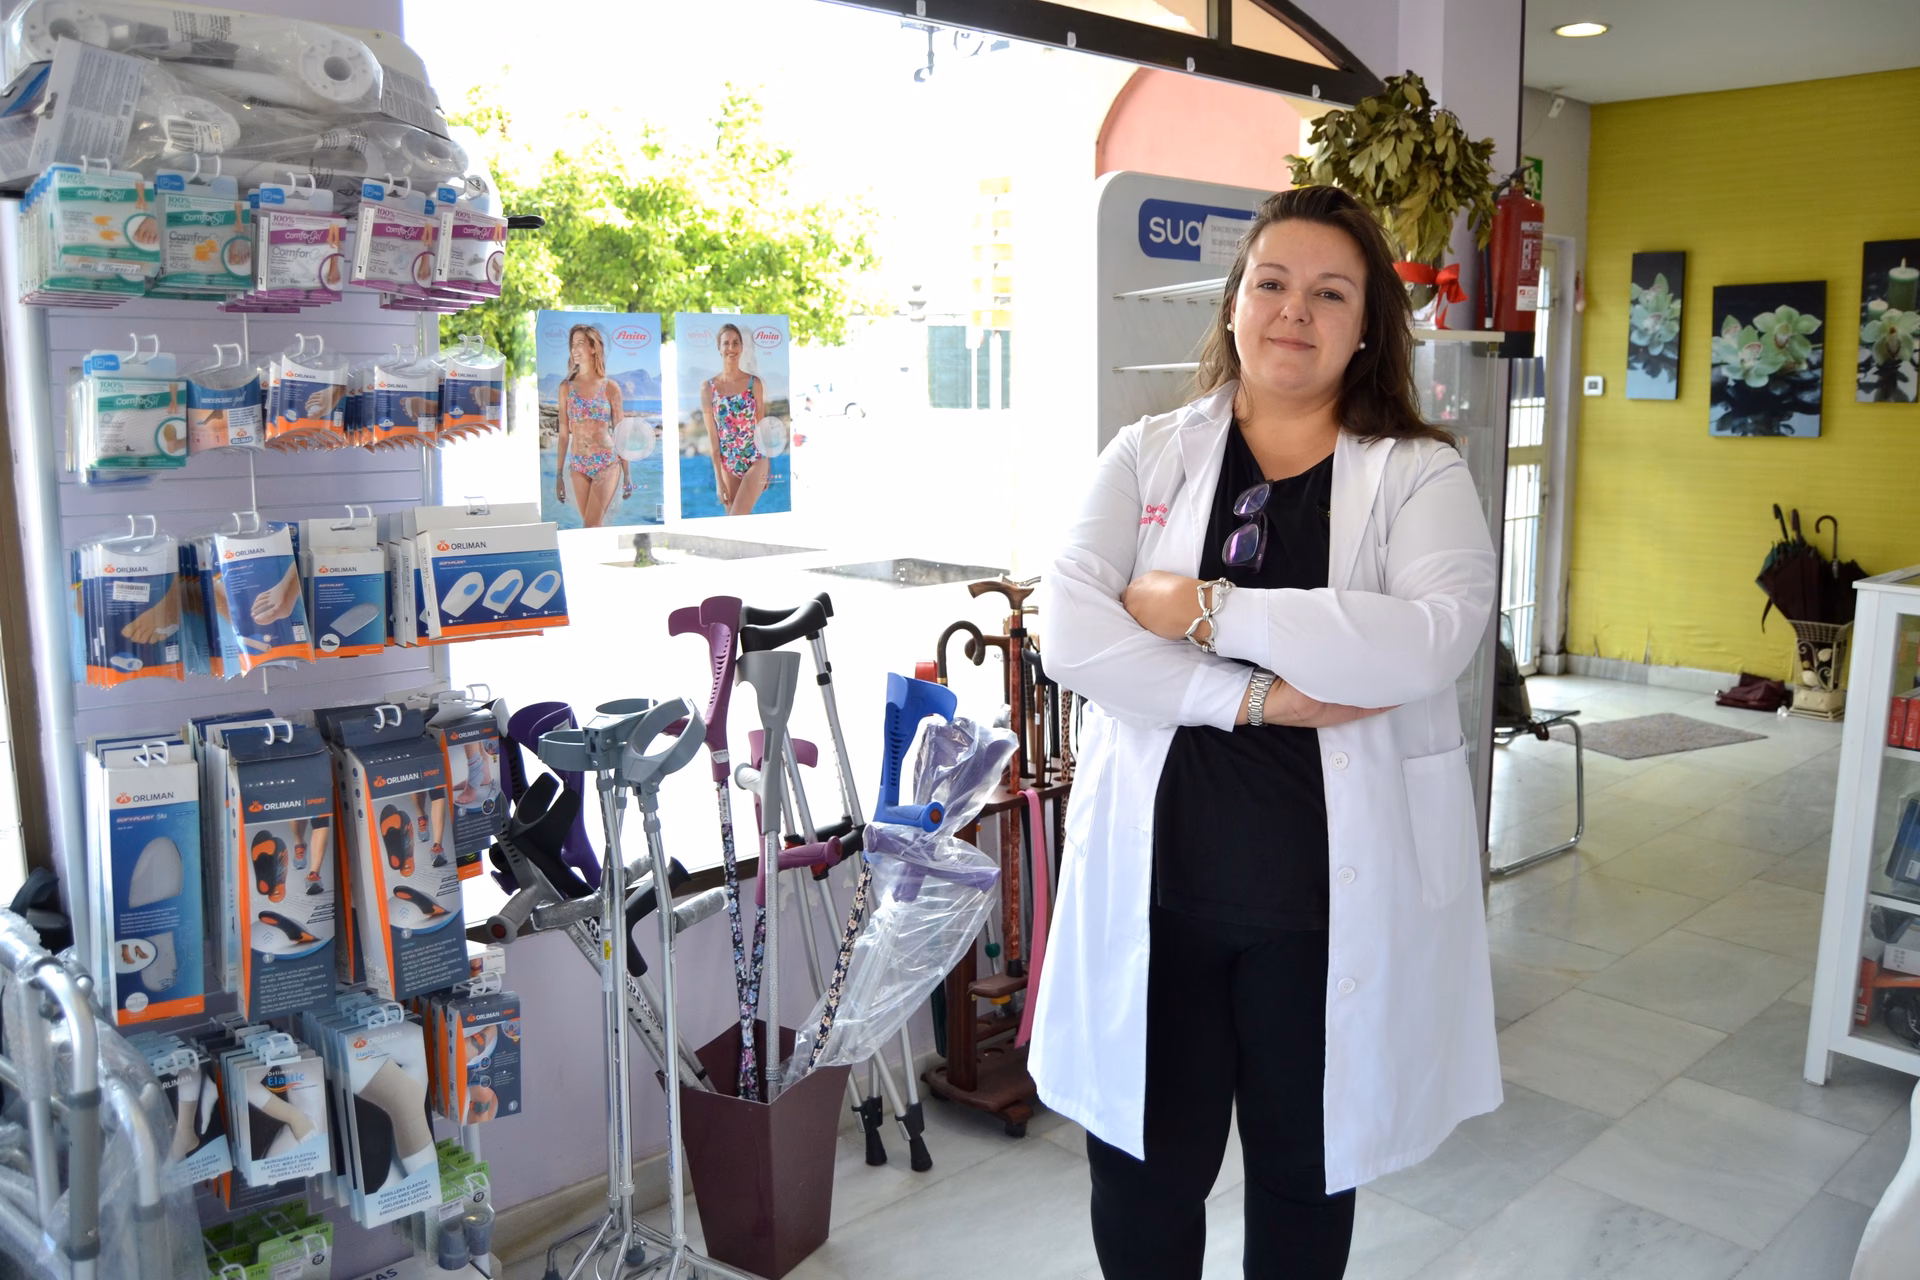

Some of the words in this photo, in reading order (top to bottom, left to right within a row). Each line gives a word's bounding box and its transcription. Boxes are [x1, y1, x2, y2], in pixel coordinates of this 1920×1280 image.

[377, 208, 396, 218] 100%
[455, 210, 472, 220] 100%
[273, 214, 295, 223] 100%
[616, 330, 647, 340] Anita
[755, 330, 780, 340] Anita
[450, 541, 487, 550] ORLIMAN
[235, 547, 266, 557] ORLIMAN
[386, 772, 420, 785] ORLIMAN
[132, 791, 175, 803] ORLIMAN
[263, 799, 302, 811] ORLIMAN
[162, 1074, 193, 1089] RLIMAN
[267, 1072, 305, 1086] Elastic
